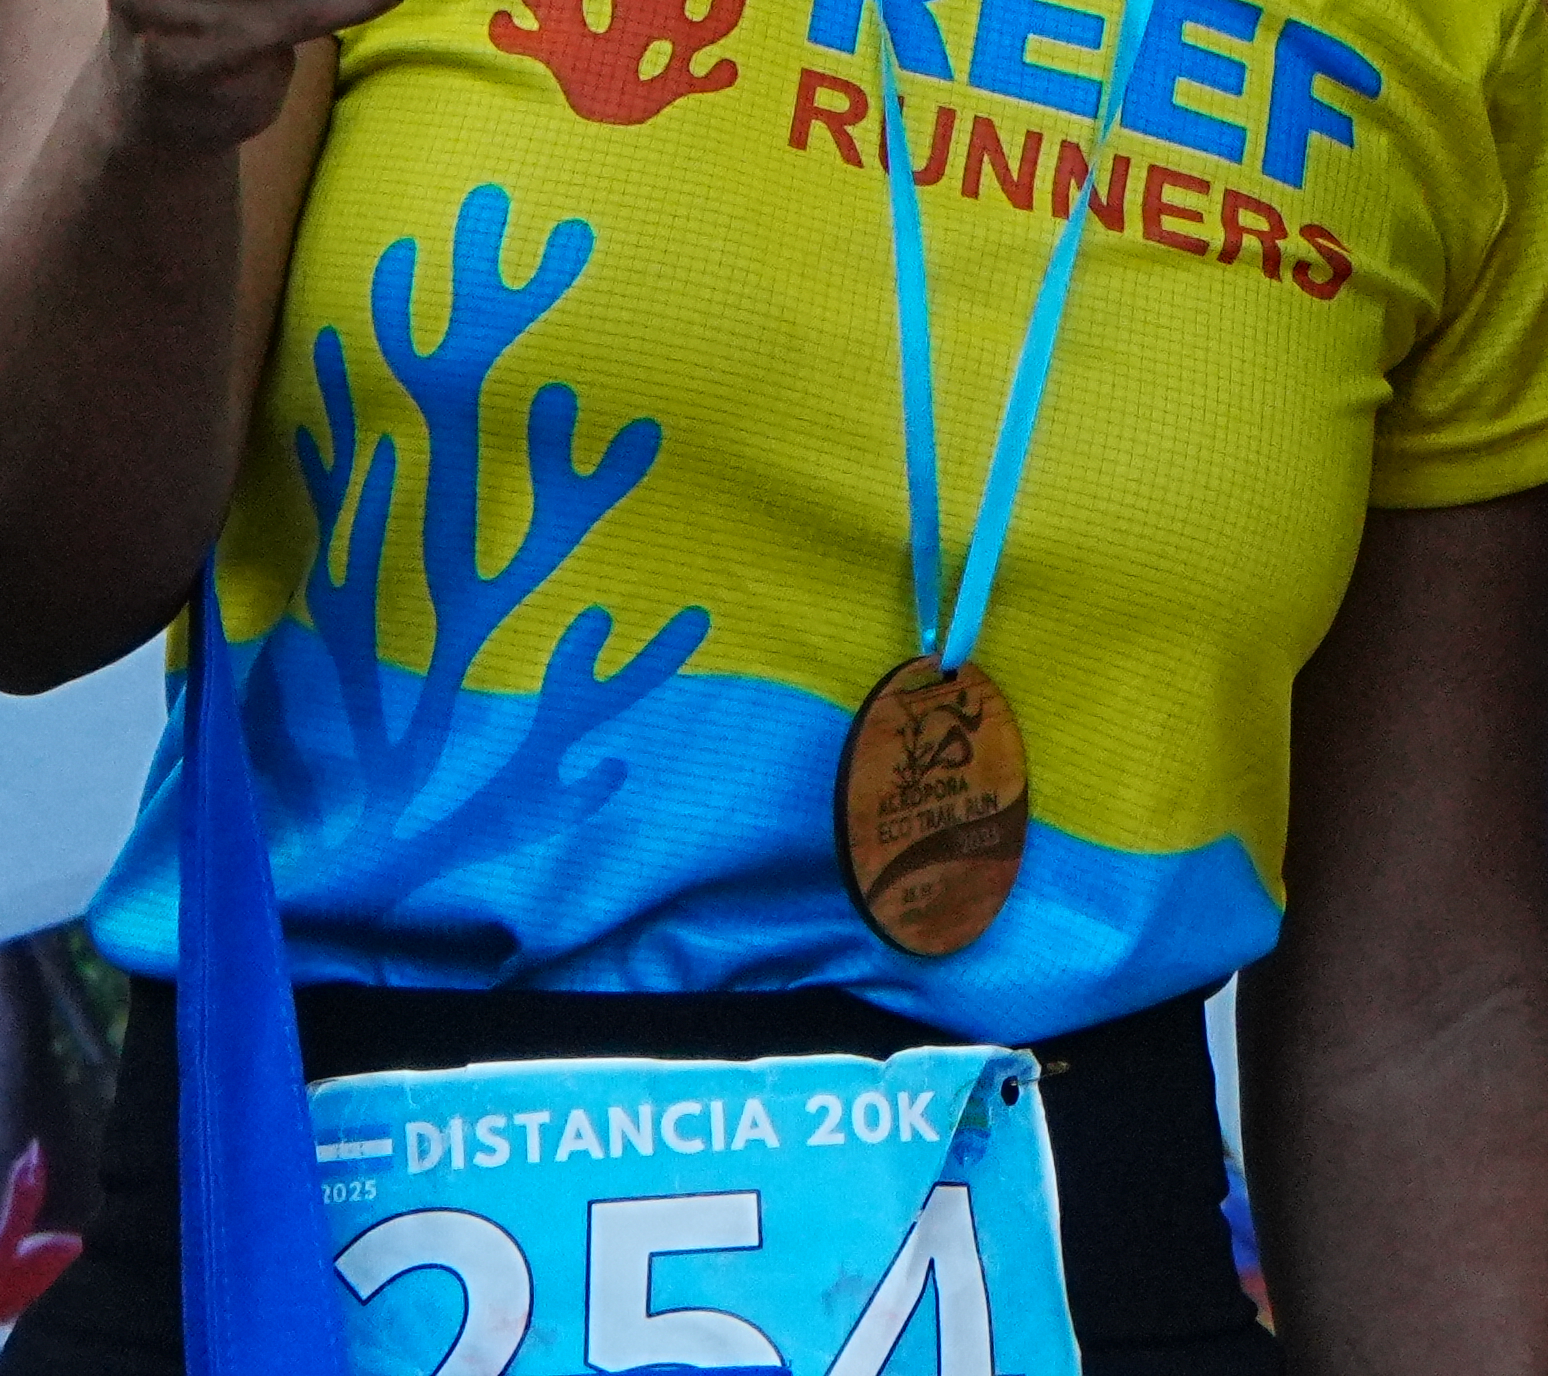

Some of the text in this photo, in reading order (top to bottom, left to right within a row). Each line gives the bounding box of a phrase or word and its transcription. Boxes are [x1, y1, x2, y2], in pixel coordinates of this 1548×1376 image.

[787, 66, 1354, 302] RUNNERS
[403, 1089, 941, 1179] DISTANCIA 20K
